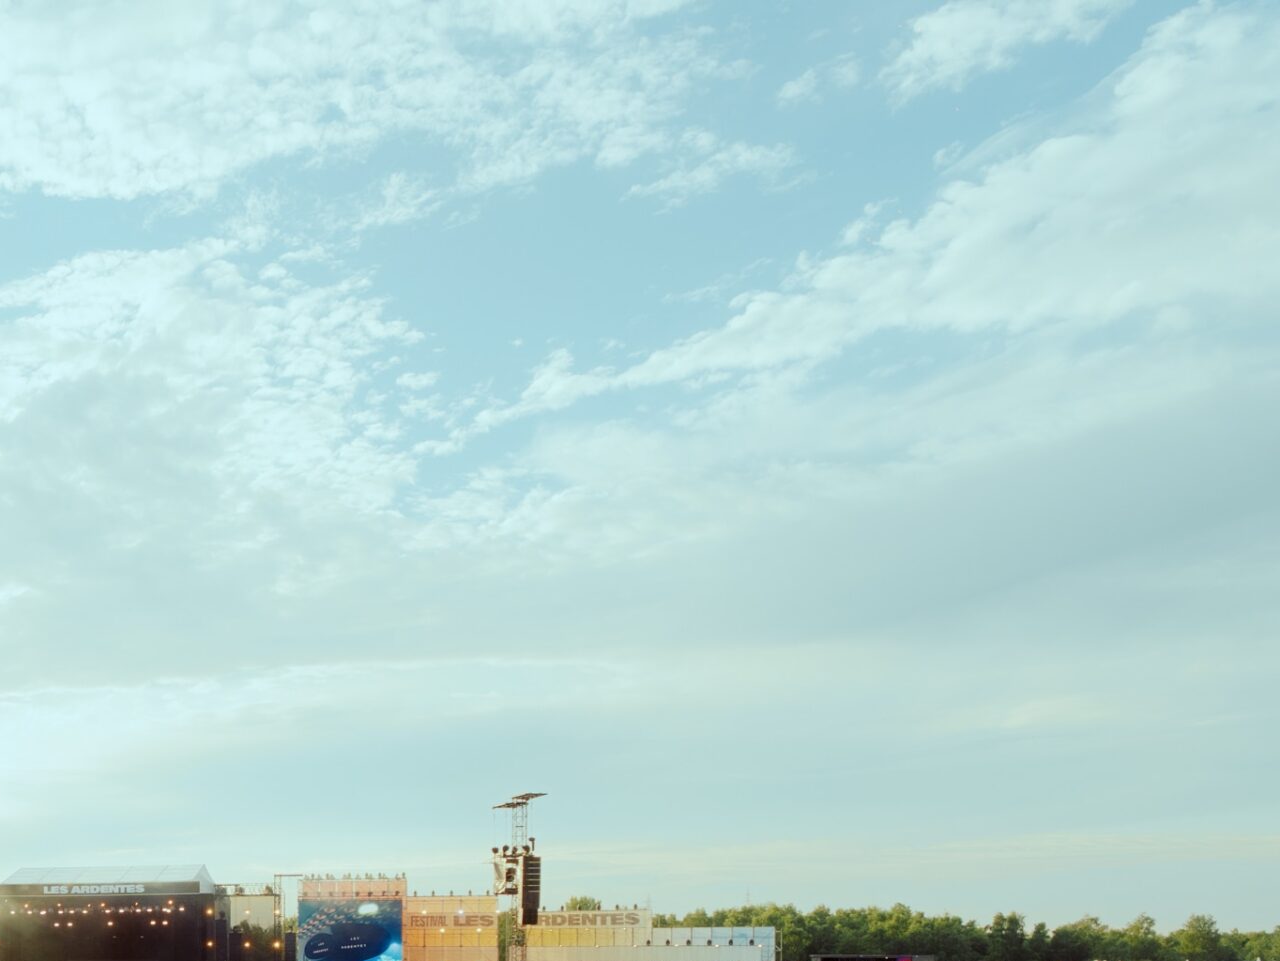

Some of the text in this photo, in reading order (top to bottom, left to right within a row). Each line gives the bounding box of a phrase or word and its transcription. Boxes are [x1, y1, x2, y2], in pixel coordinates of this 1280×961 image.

[43, 884, 145, 894] LES ARDENTES
[411, 912, 640, 927] FESTIVAL LES RDENTES
